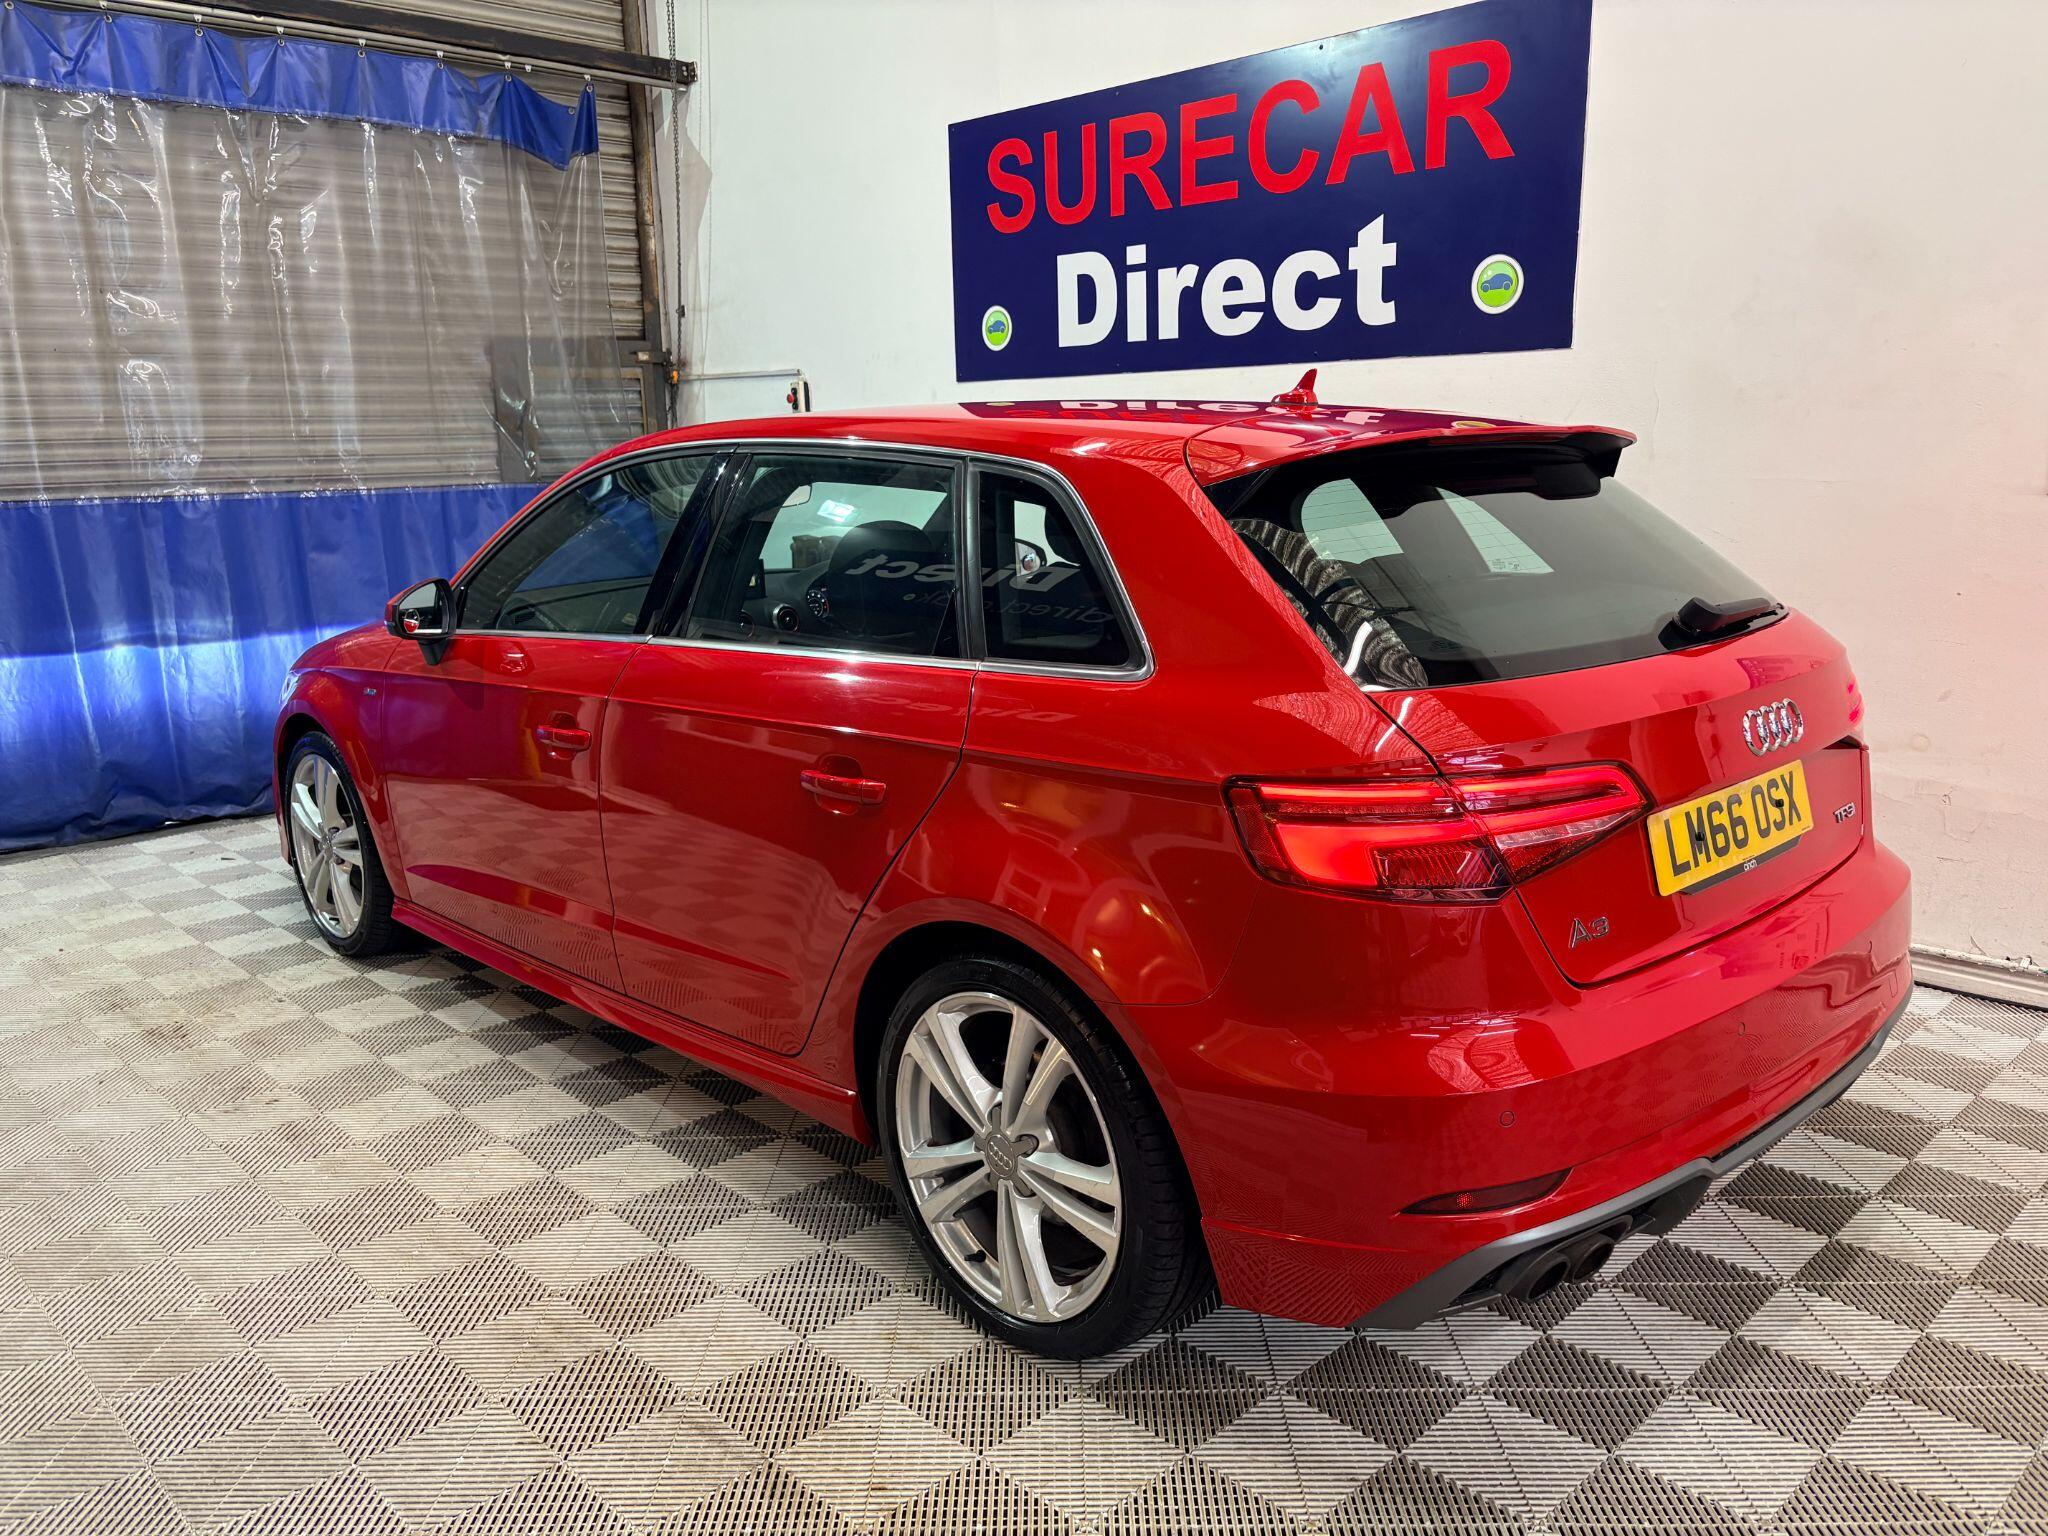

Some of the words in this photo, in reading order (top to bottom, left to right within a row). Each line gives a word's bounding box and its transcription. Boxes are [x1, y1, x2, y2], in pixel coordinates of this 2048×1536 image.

[986, 39, 1514, 234] SURECAR
[1056, 214, 1397, 348] Direct
[1663, 794, 1749, 877] LM66
[1751, 771, 1801, 839] OSX
[1568, 916, 1609, 949] A3
